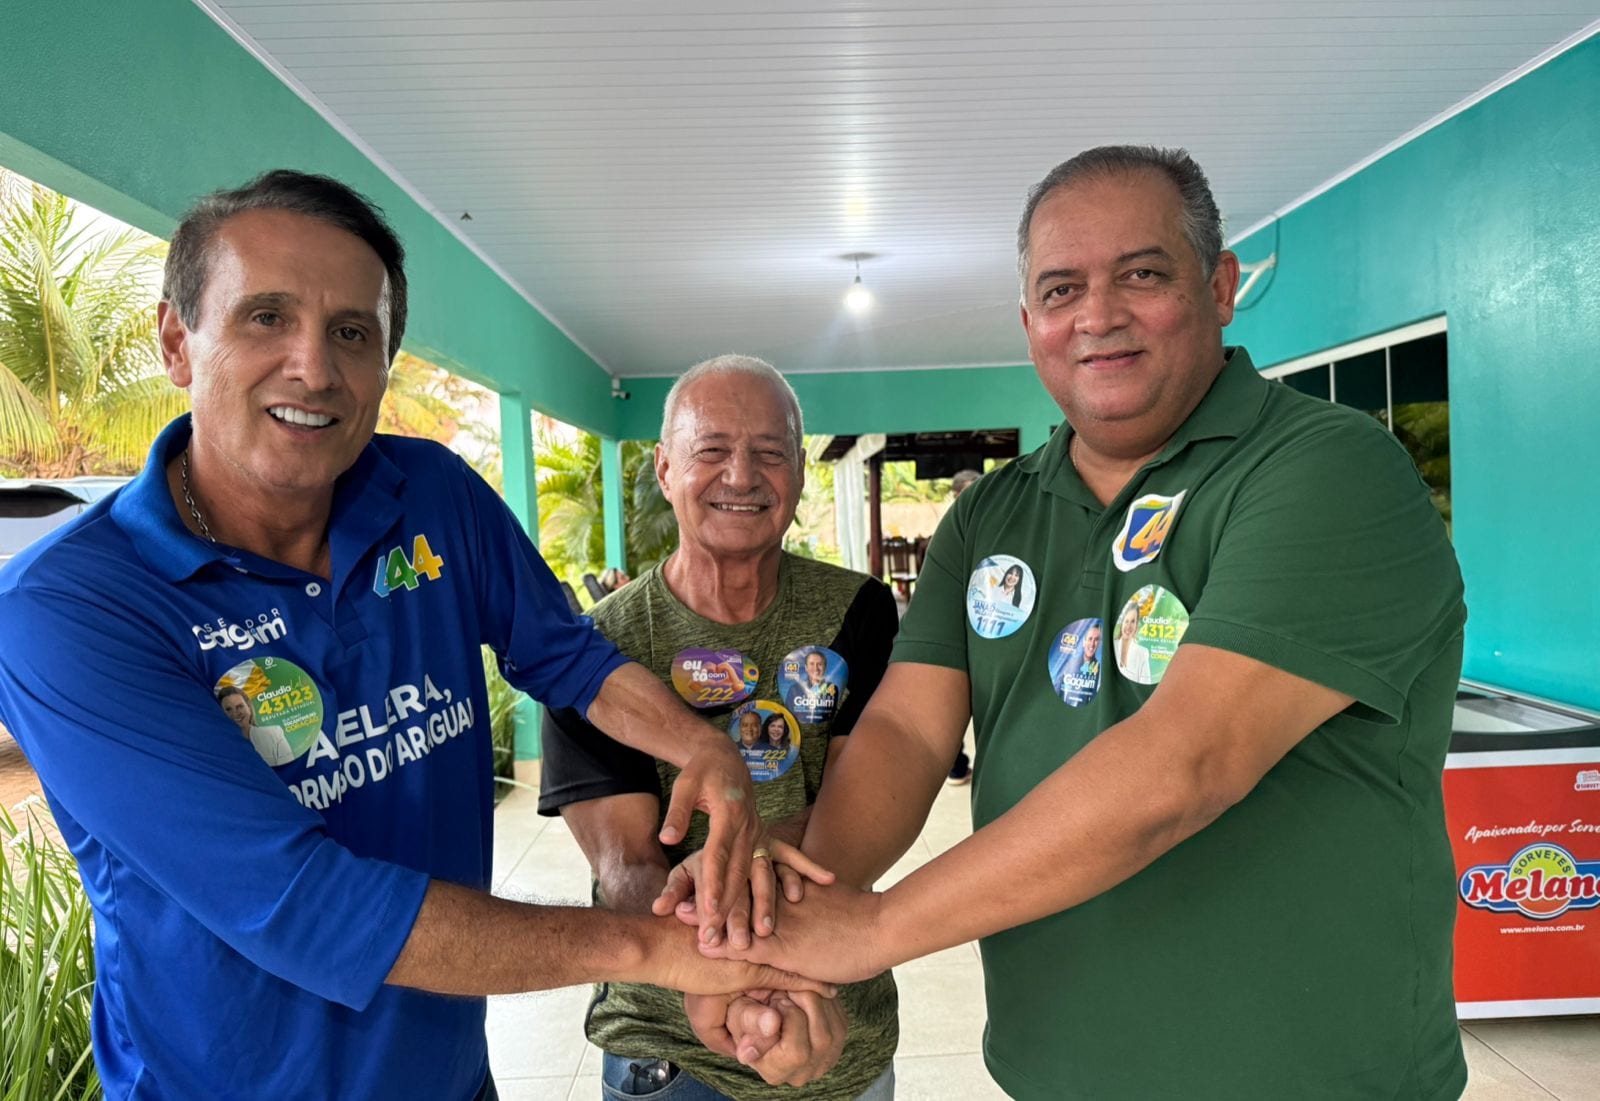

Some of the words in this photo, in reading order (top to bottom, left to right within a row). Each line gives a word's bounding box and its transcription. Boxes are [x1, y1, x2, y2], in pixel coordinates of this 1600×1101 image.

[1130, 510, 1174, 552] 44
[204, 608, 280, 633] SEDOR
[683, 660, 702, 671] eu
[692, 668, 708, 682] tô
[257, 685, 292, 702] Claudia
[258, 685, 313, 715] 43123
[697, 687, 735, 702] 222
[306, 673, 452, 768] AELERA,
[763, 749, 787, 760] 222
[1464, 820, 1542, 844] Apaixonados
[1541, 823, 1567, 837] por
[1513, 850, 1572, 875] SORVETES
[1467, 869, 1600, 902] Melan
[1499, 924, 1585, 934] www.melano.com.br
